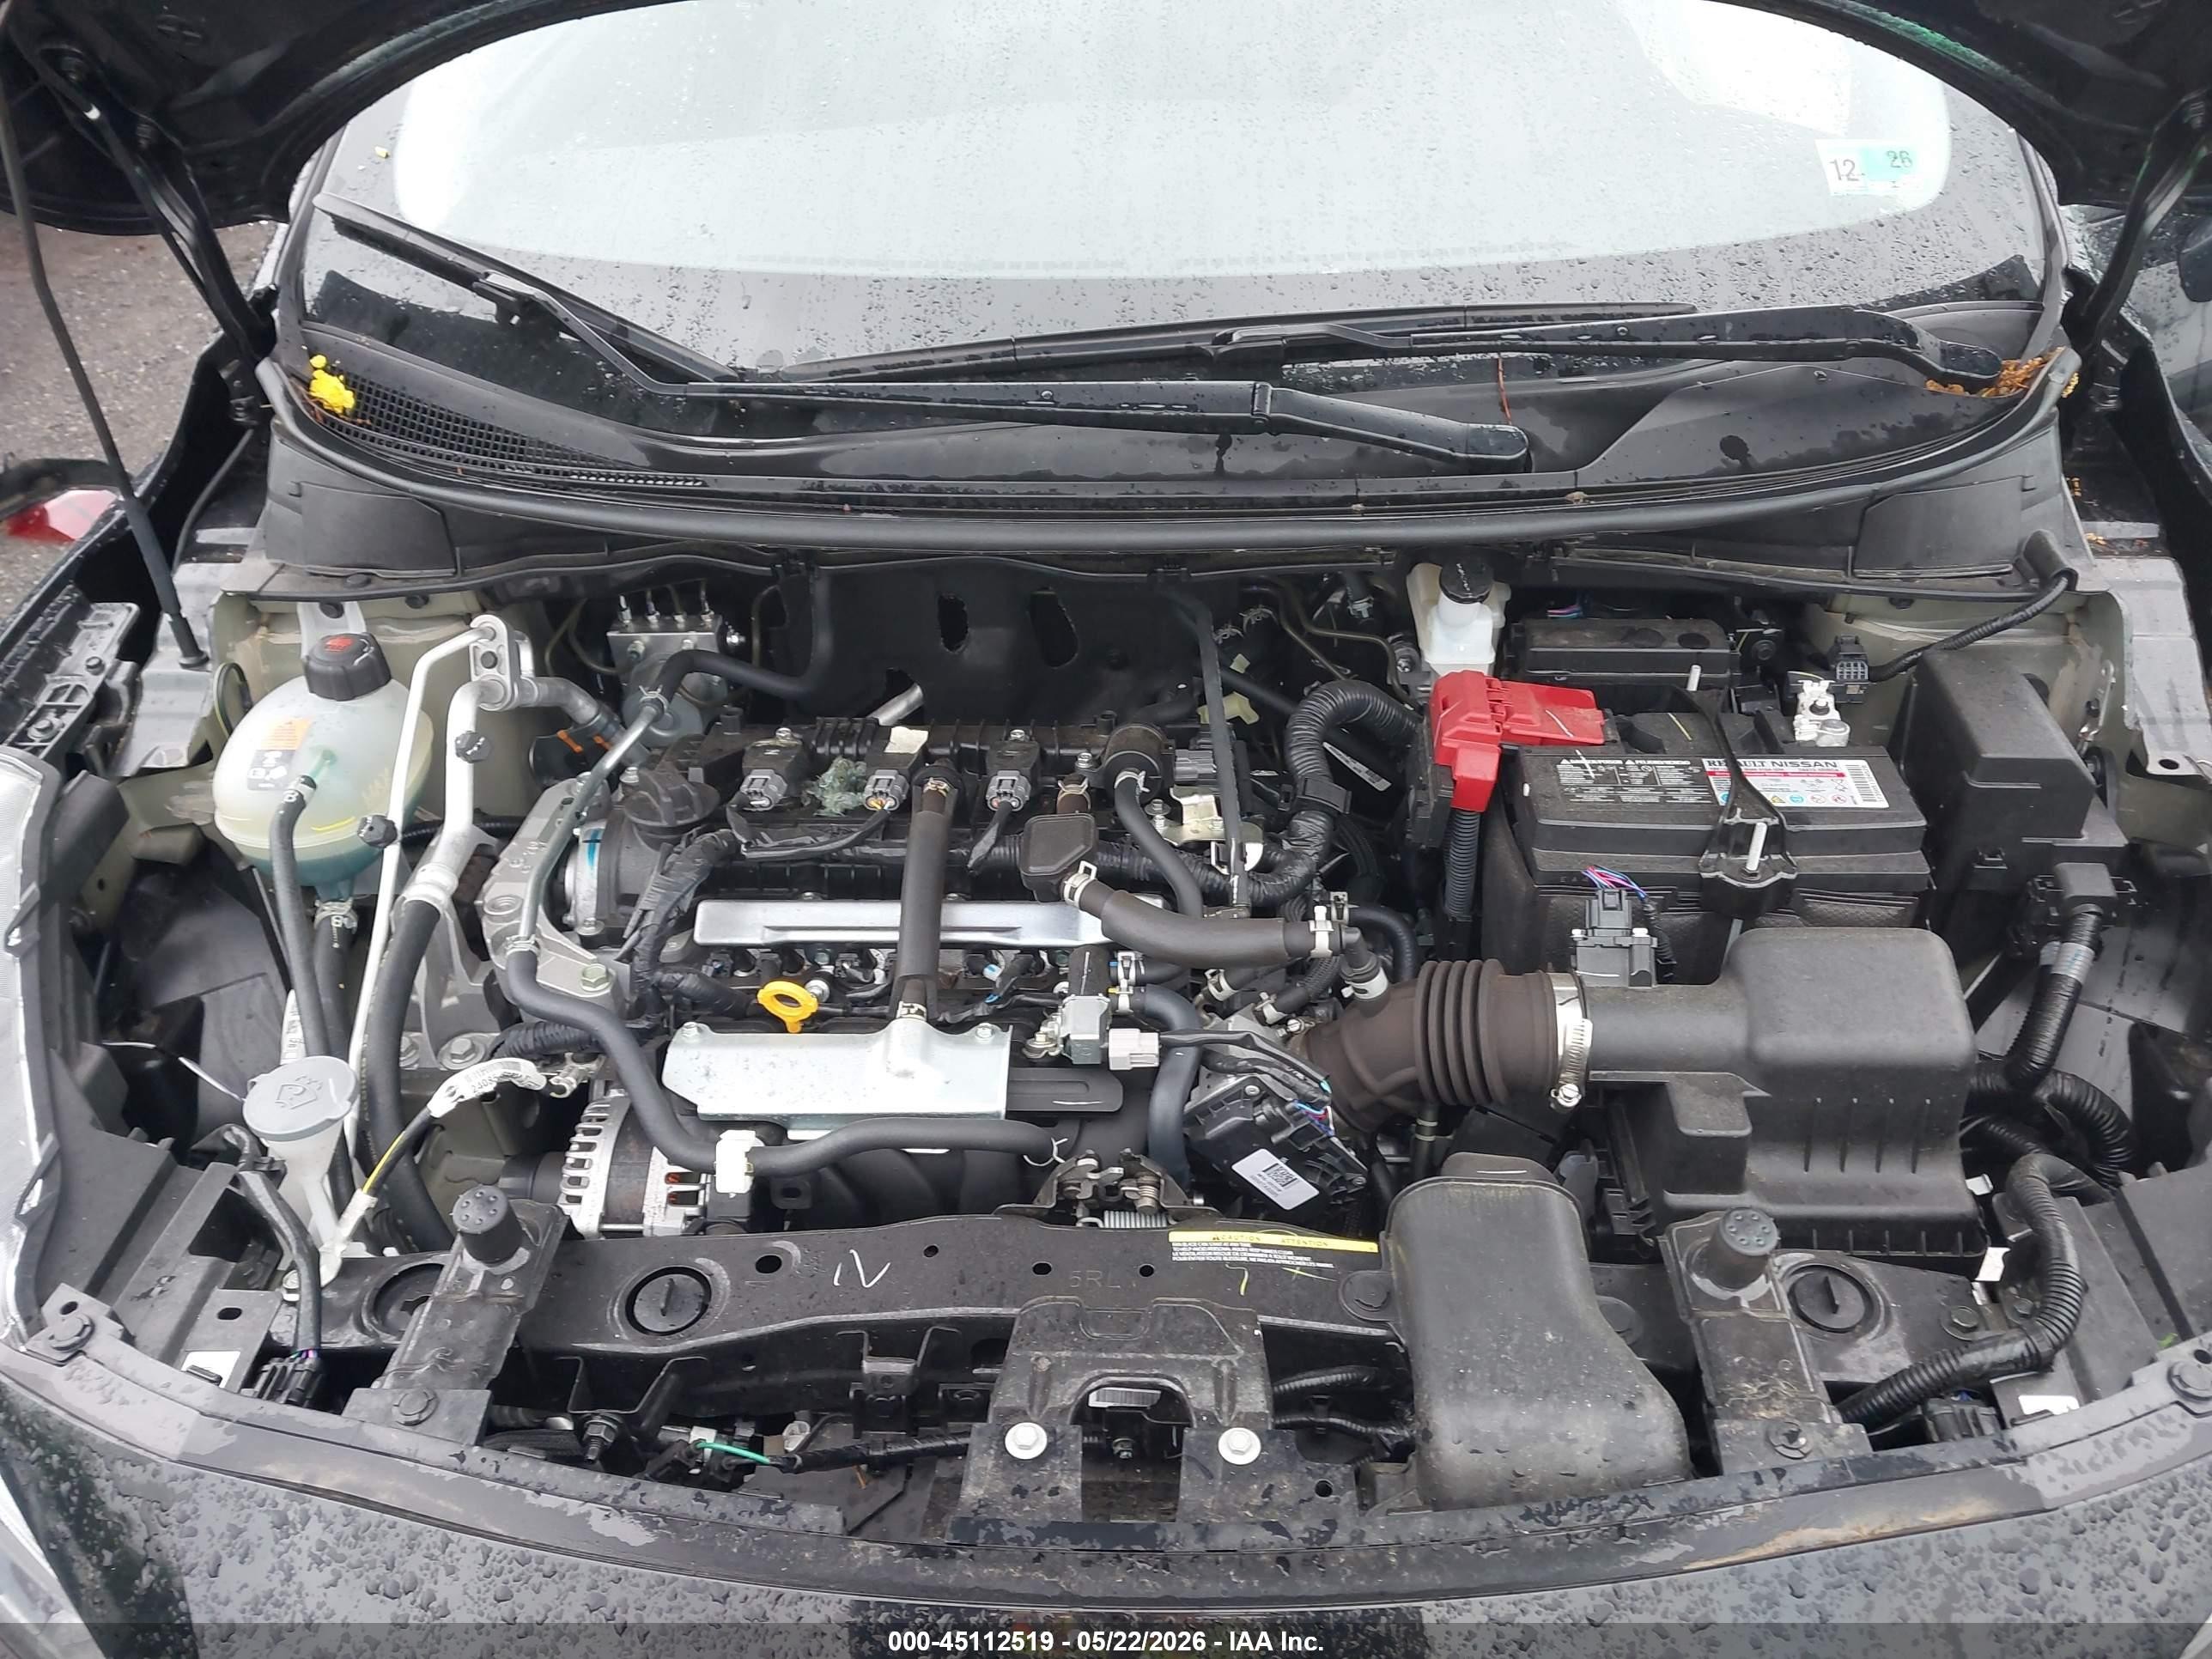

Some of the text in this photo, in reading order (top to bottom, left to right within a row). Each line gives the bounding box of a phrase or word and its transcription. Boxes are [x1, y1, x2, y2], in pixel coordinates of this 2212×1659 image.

[1886, 149, 1913, 169] 26
[1829, 158, 1860, 182] 12
[1280, 1238, 1328, 1247] ATTENTION
